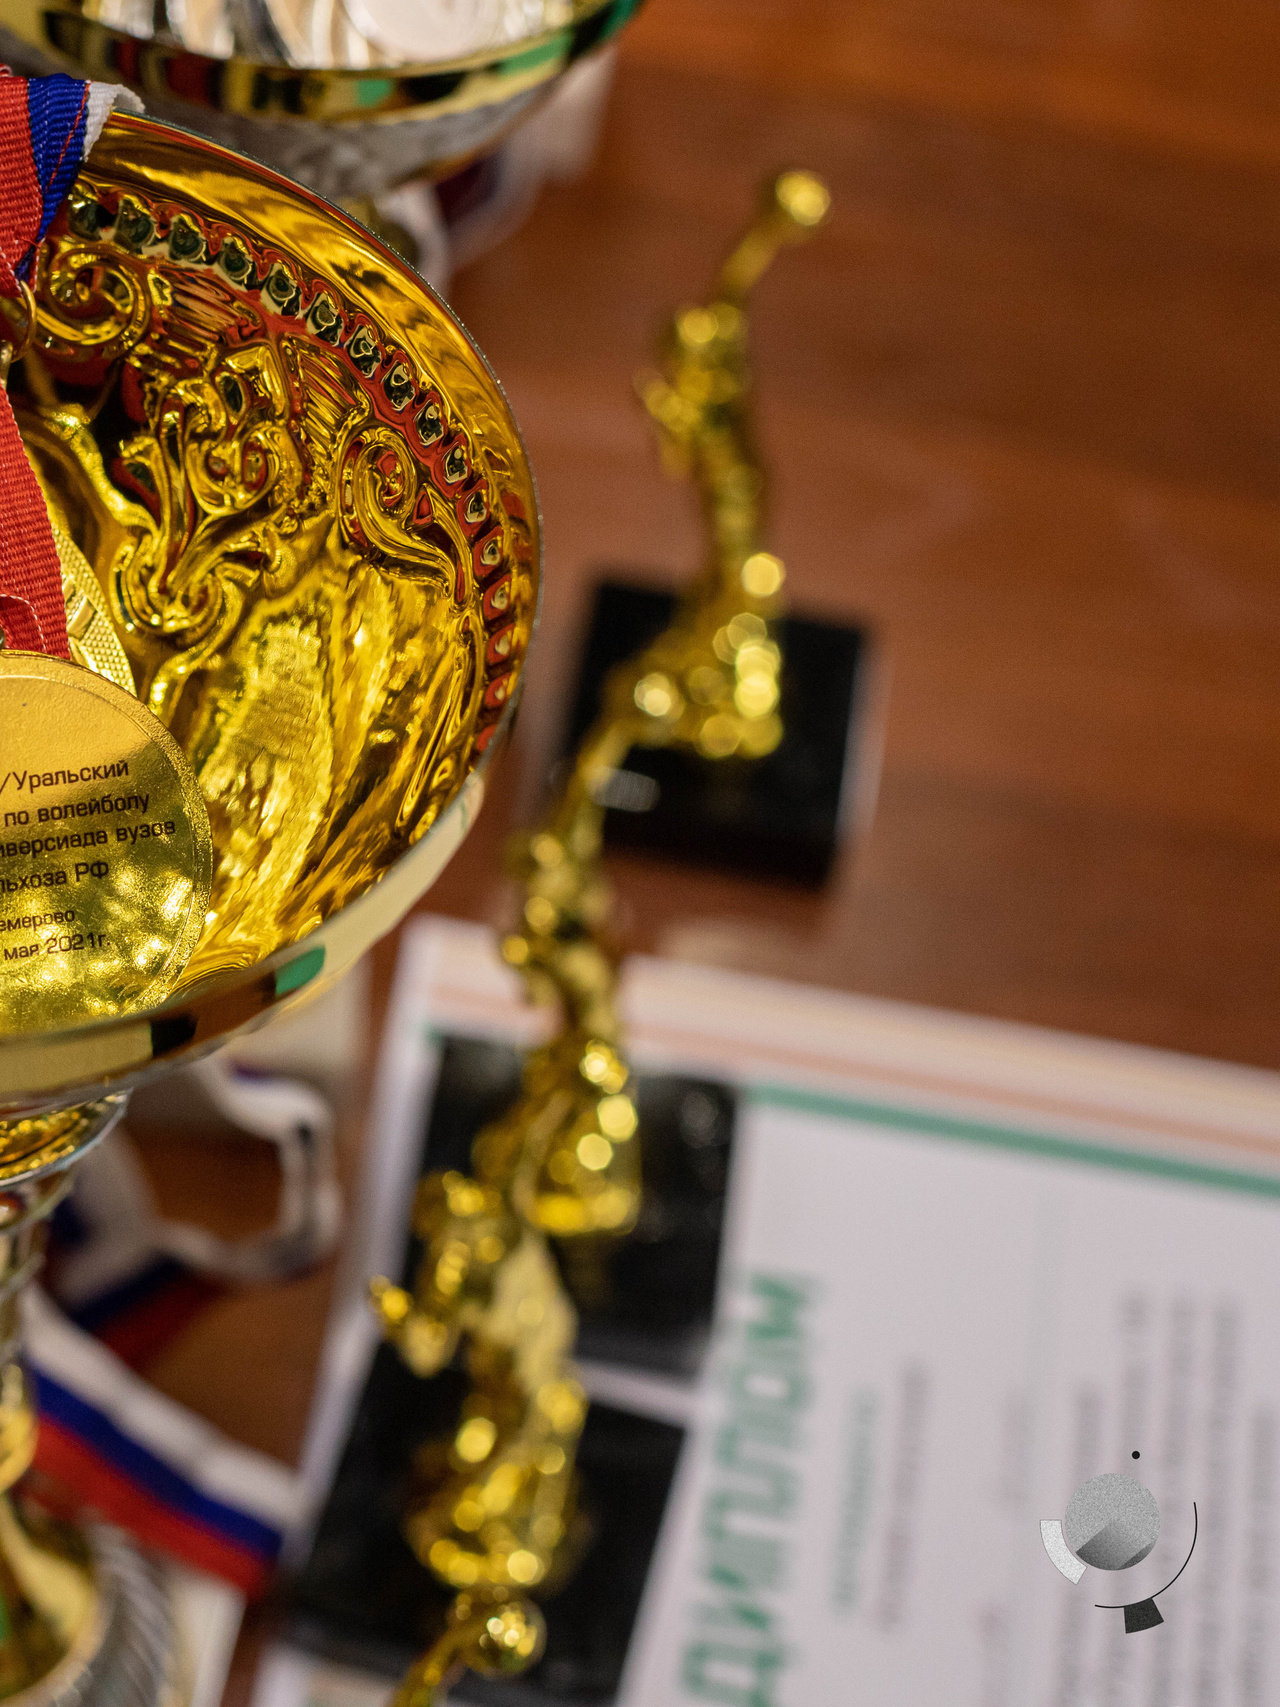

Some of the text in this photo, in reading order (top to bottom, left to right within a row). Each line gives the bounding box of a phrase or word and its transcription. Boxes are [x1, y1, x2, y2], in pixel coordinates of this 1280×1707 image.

[4, 810, 30, 827] по
[37, 793, 150, 822] волейболу
[115, 820, 177, 845] вузов
[74, 861, 110, 883] РФ
[4, 943, 40, 961] мая
[45, 932, 112, 955] 2021г.
